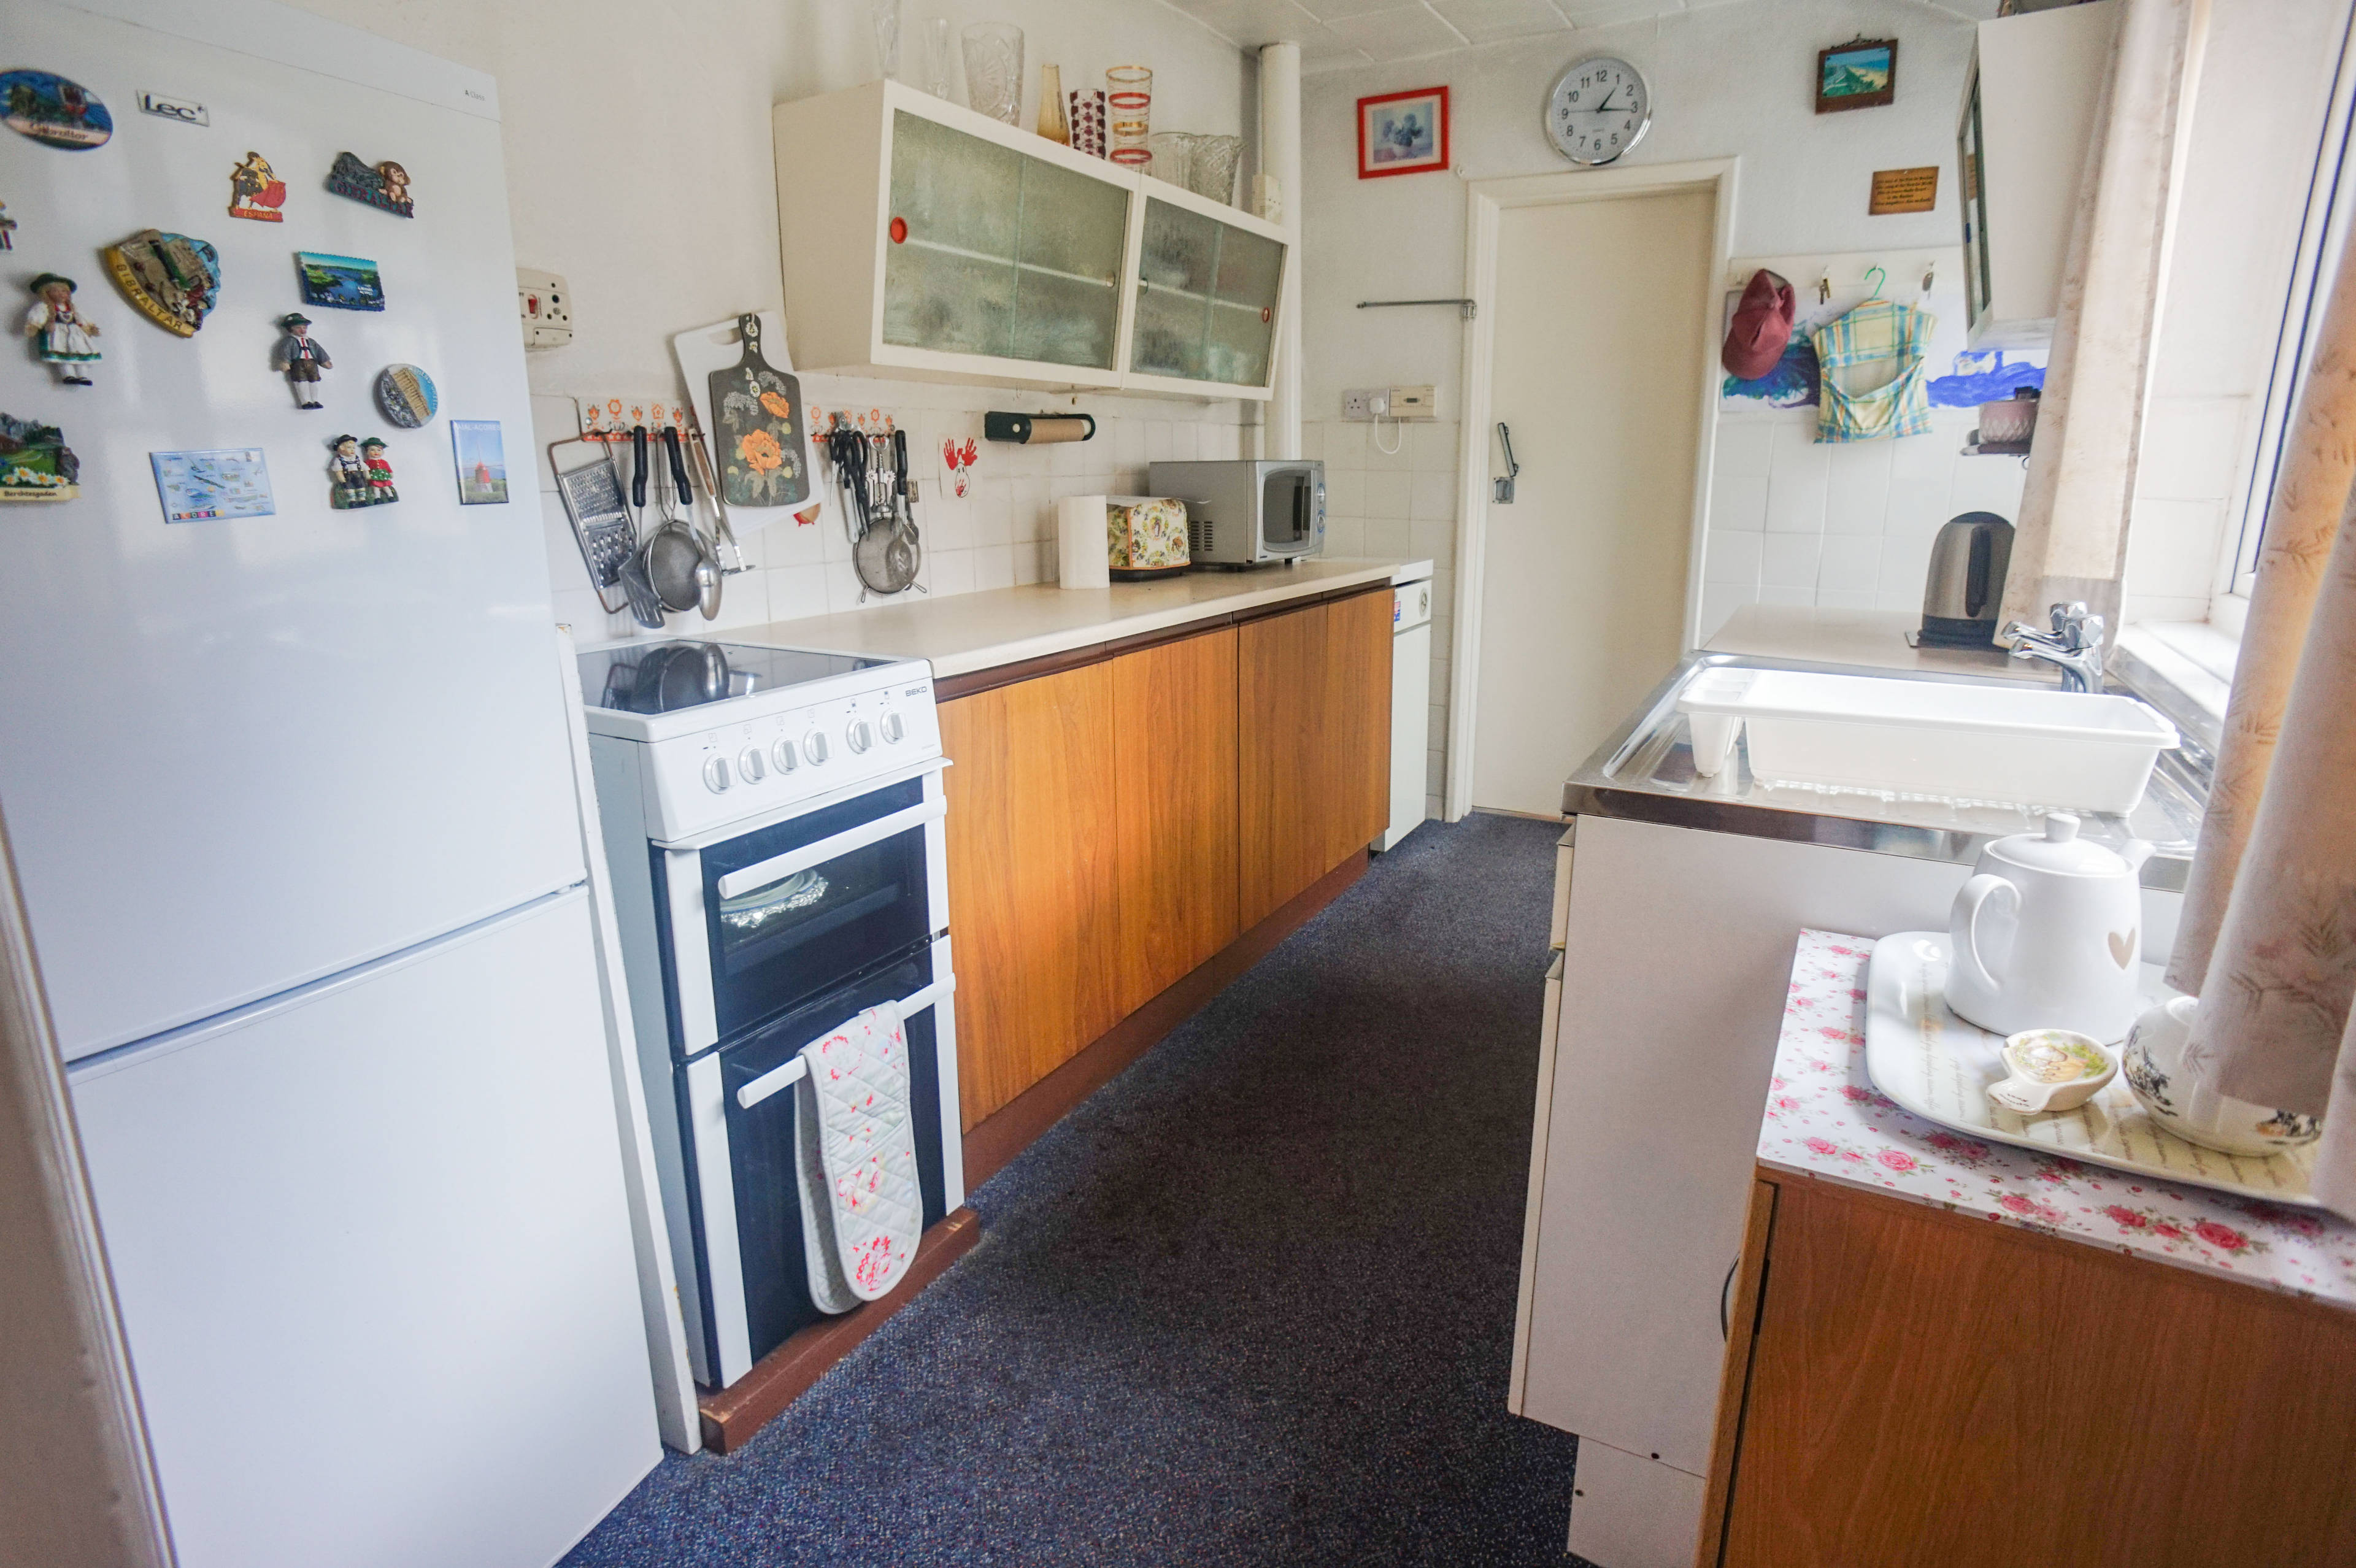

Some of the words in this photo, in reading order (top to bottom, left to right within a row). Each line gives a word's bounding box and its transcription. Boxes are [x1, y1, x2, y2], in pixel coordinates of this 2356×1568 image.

[1596, 70, 1607, 82] 12
[1615, 74, 1620, 85] 1
[1580, 77, 1590, 88] 11
[1626, 85, 1634, 96] 2
[1568, 91, 1579, 102] 10
[144, 94, 197, 121] Lec
[1631, 101, 1638, 113] 3
[1561, 108, 1569, 120] 9
[1566, 125, 1573, 137] 8
[1624, 120, 1631, 131] 4
[1579, 136, 1586, 147] 7
[1594, 139, 1601, 150] 6
[1611, 133, 1618, 145] 5
[334, 180, 414, 218] GIBRALTAR
[117, 264, 183, 330] GIBRALTAR
[905, 686, 927, 697] BEKO
